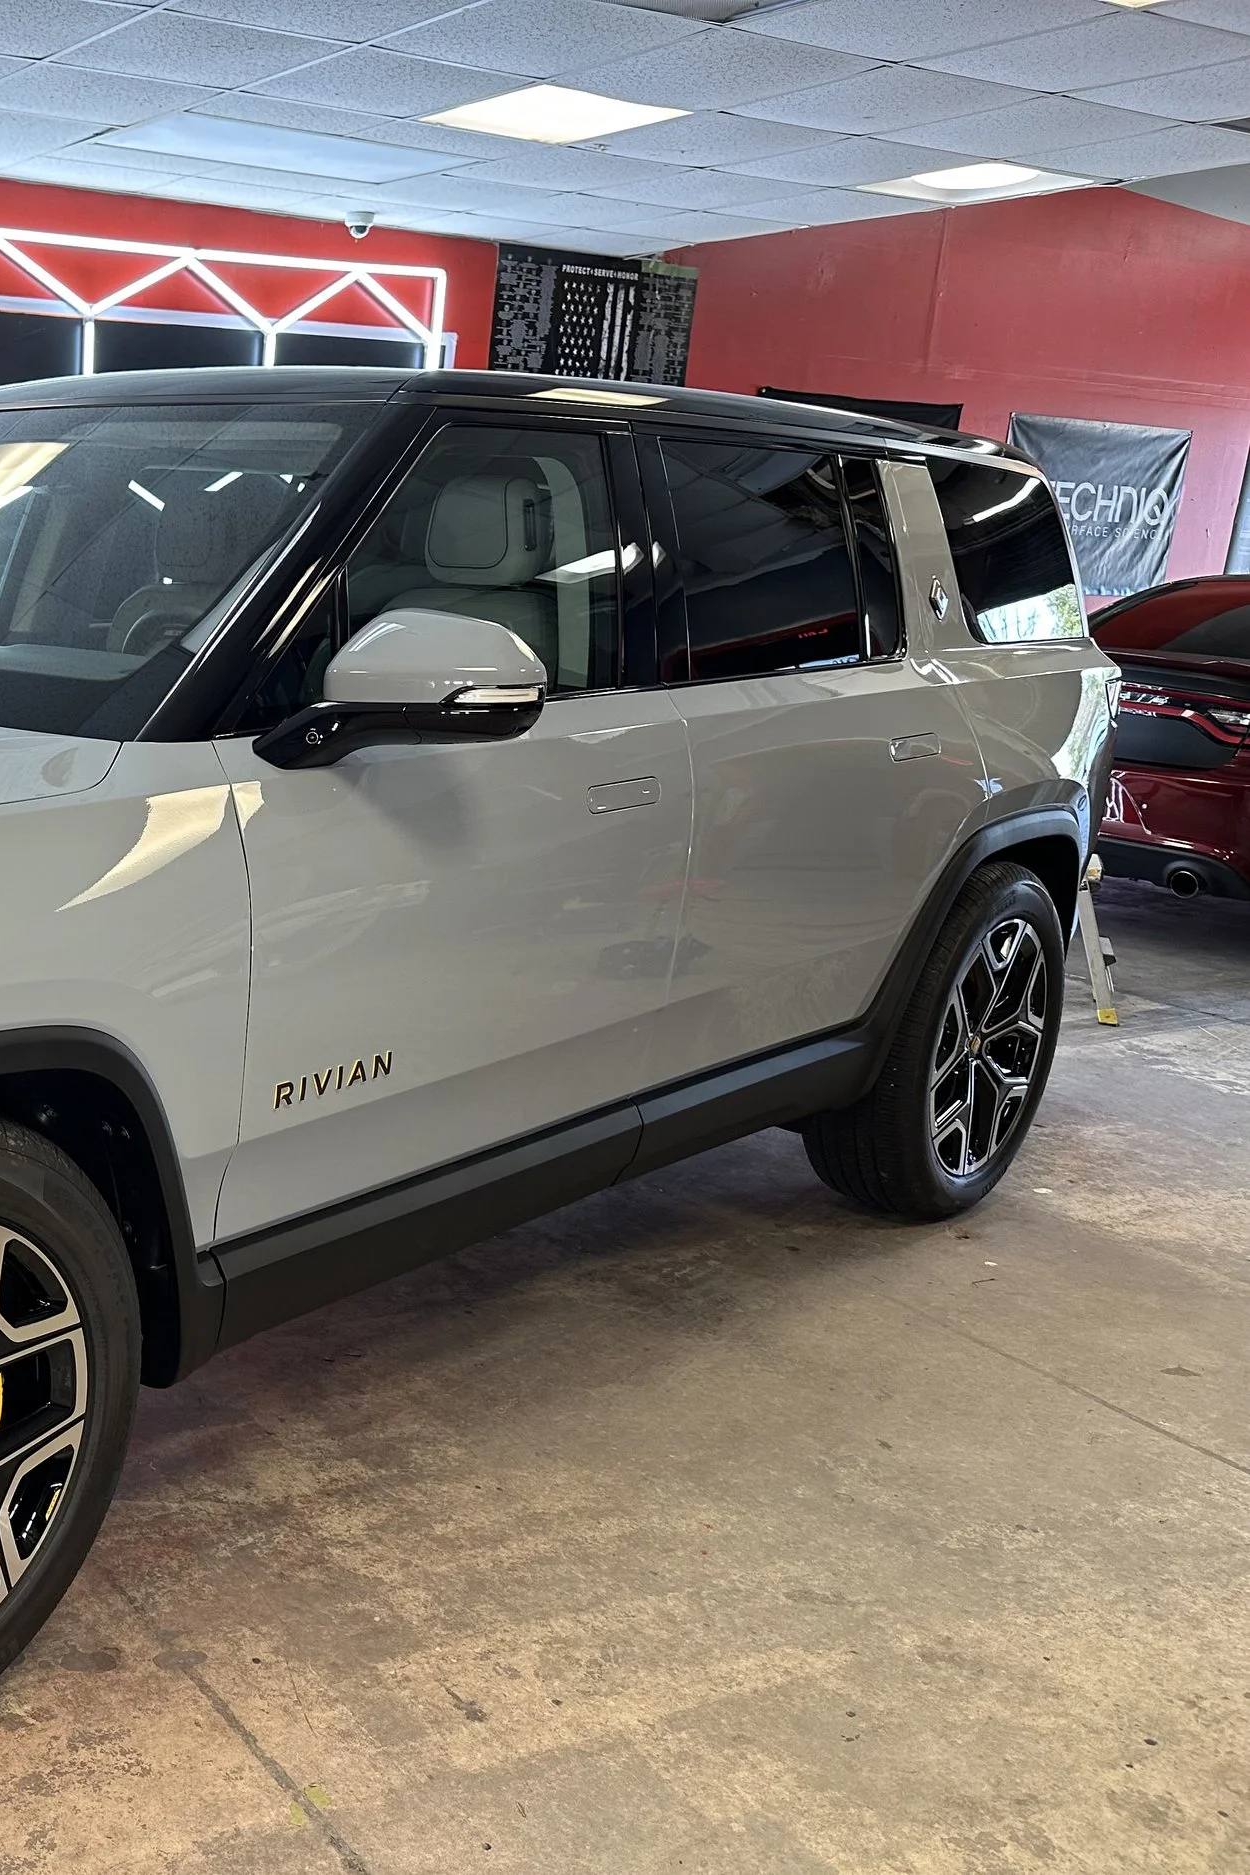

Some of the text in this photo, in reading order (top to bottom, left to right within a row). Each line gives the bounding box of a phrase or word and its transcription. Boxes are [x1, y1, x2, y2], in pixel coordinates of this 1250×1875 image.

[561, 264, 639, 280] PROTECT SERVE HONOR
[272, 1049, 393, 1111] RIVIAN
